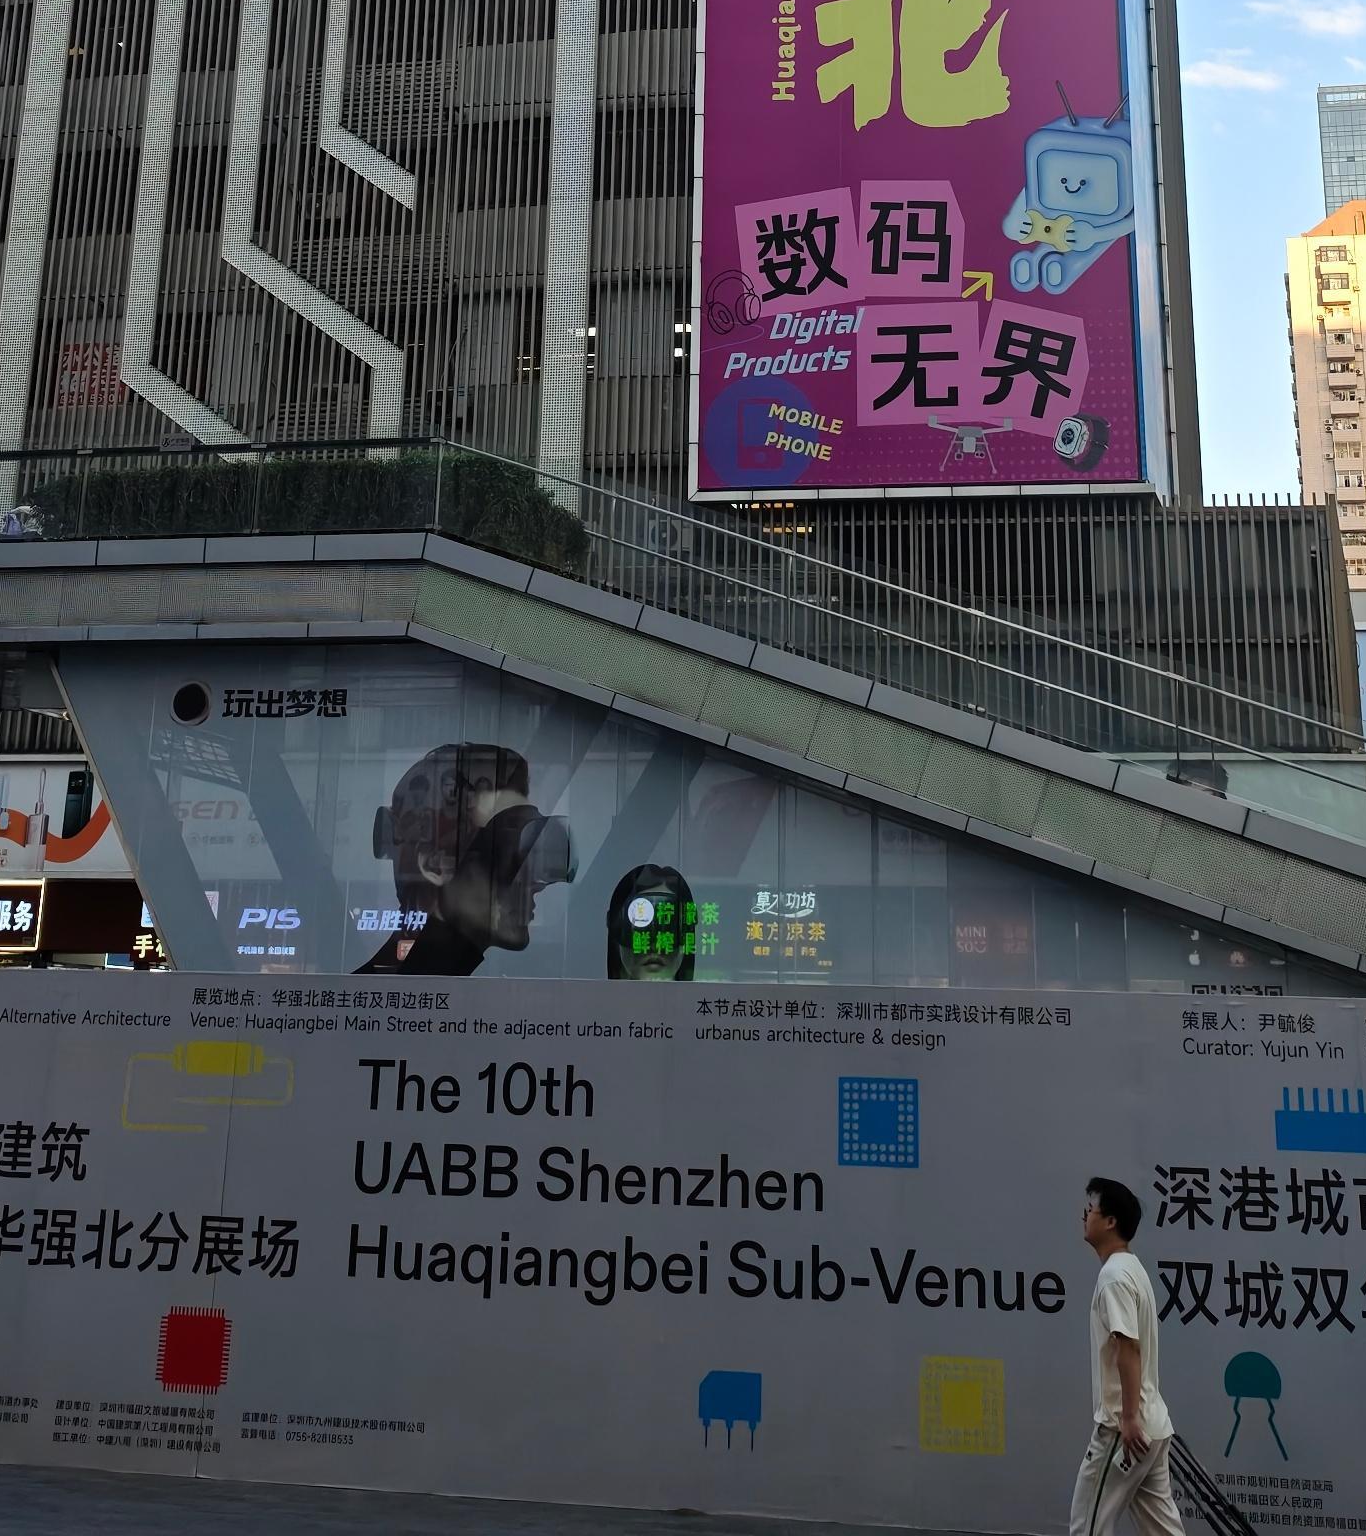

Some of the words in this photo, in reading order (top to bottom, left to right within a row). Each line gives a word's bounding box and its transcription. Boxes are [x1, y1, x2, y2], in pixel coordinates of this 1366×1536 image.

[756, 201, 952, 302] 数码
[770, 308, 865, 345] Digital
[723, 346, 850, 379] Products
[870, 320, 1076, 418] 无界
[768, 403, 843, 435] MOBILE
[765, 431, 833, 461] PHONE
[223, 689, 348, 718] 玩出梦想
[238, 909, 301, 929] PIS
[955, 926, 987, 938] MINI
[633, 932, 720, 956] 鲜榨果汁
[81, 1009, 172, 1027] Architecture
[190, 1012, 239, 1029] Venue:
[245, 1013, 338, 1036] Huaqiangbei
[344, 1015, 381, 1032] Main
[386, 1016, 433, 1033] Street
[438, 1017, 467, 1034] and
[473, 1018, 499, 1035] the
[503, 1019, 571, 1040] adjacent
[576, 1021, 623, 1039] urban
[628, 1021, 674, 1040] fabric
[696, 998, 1072, 1026] 本节点设计单位：深圳市都市实践设计有限公司
[1182, 1010, 1316, 1035] 策展人：尹毓俊
[695, 1026, 760, 1043] urbanus
[766, 1027, 865, 1046] architecture
[872, 1030, 885, 1045] &
[891, 1030, 947, 1051] design
[1182, 1037, 1254, 1058] Curator:
[1261, 1039, 1309, 1064] Yujun
[1315, 1041, 1345, 1060] Yin
[358, 1058, 462, 1114] The
[477, 1062, 596, 1118] 10th
[352, 1140, 519, 1199] UABB
[536, 1145, 825, 1213] Shenzhen
[346, 1223, 709, 1306] Huaqiangbei
[727, 1240, 1067, 1314] Sub-Venue
